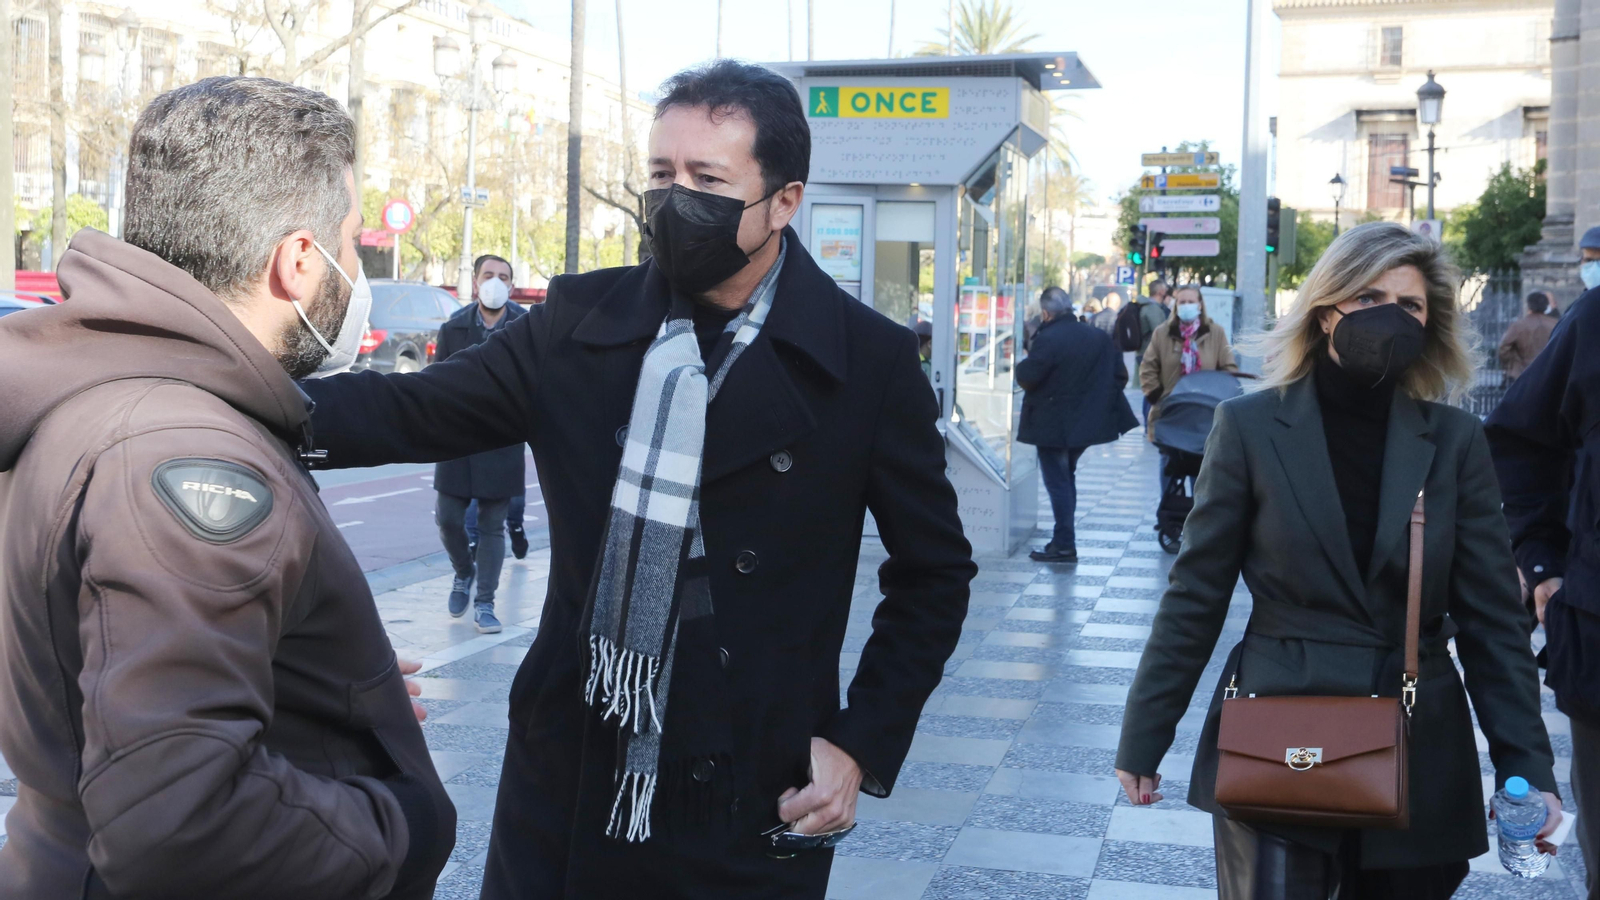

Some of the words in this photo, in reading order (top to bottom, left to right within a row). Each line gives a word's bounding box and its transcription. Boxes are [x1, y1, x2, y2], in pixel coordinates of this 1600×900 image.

[851, 92, 938, 113] ONCE
[1156, 176, 1164, 187] P
[1119, 267, 1132, 283] P
[181, 481, 258, 503] RICHA
